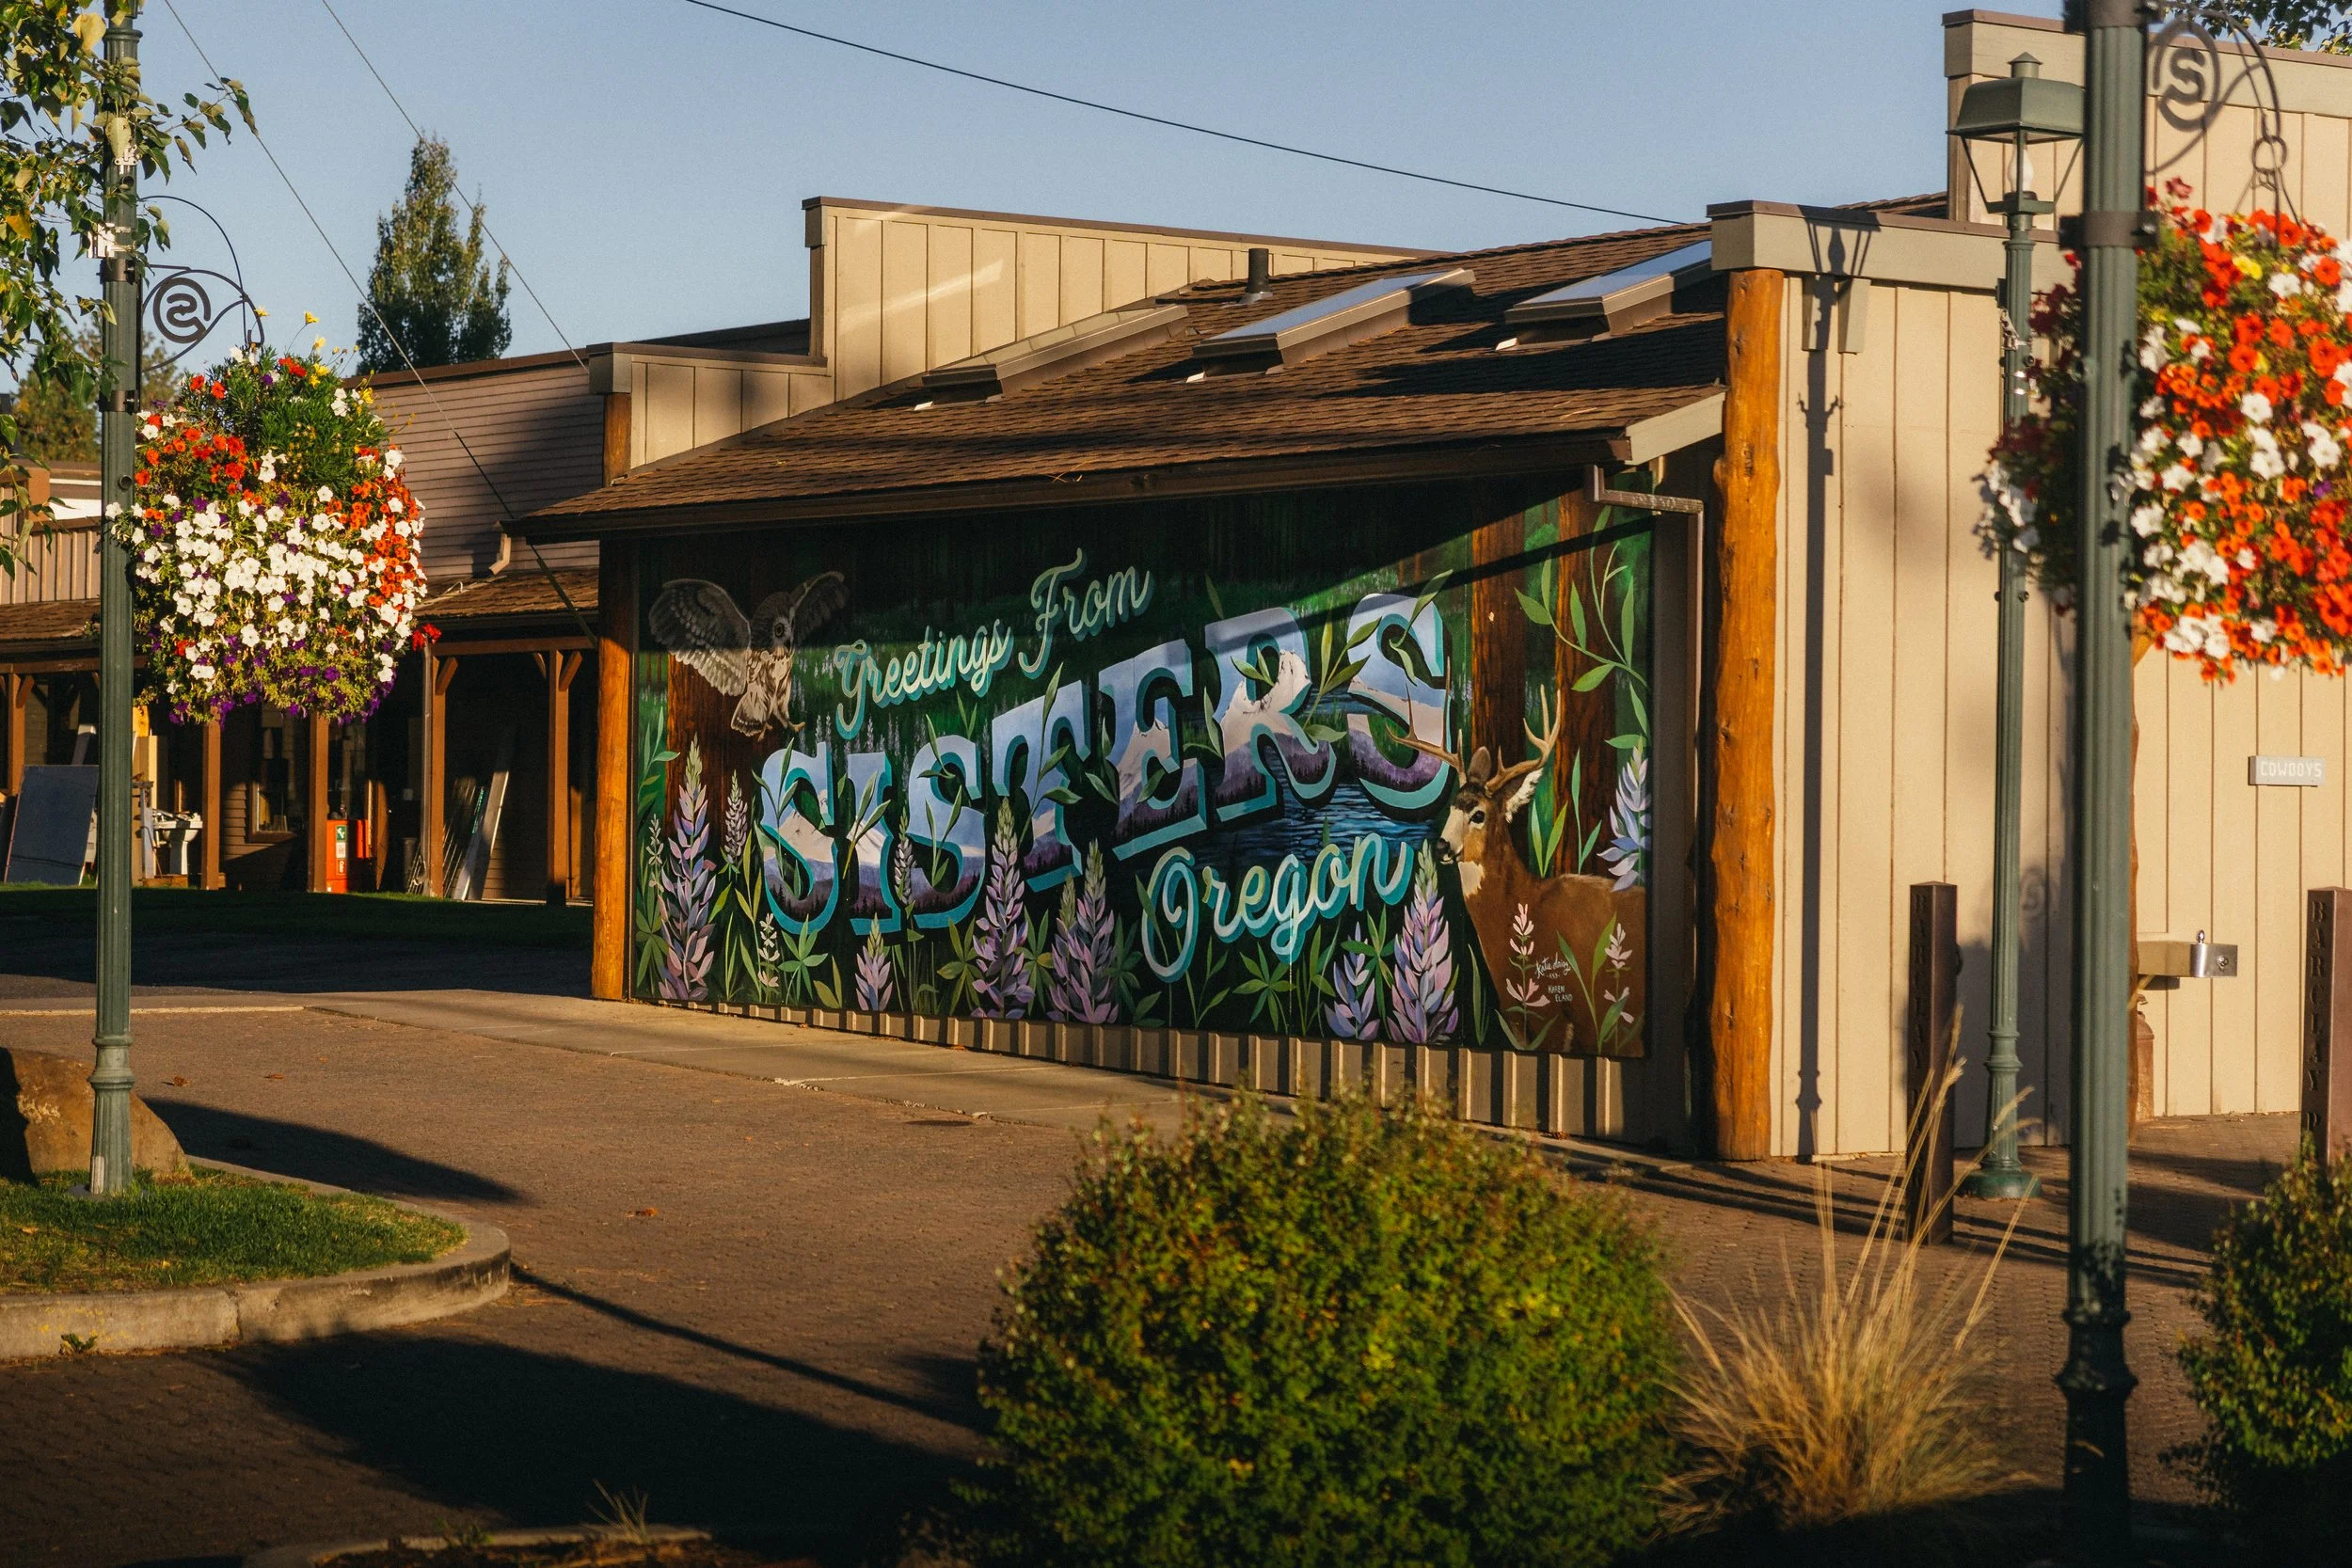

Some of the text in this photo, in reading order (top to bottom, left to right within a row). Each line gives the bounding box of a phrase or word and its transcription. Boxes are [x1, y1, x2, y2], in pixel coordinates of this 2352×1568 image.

[834, 547, 1155, 738] Greetings From
[760, 593, 1453, 936] SISTERS
[2260, 760, 2323, 778] COWBOYS
[1141, 832, 1415, 983] Oregon
[2307, 900, 2325, 1092] BARCLAY
